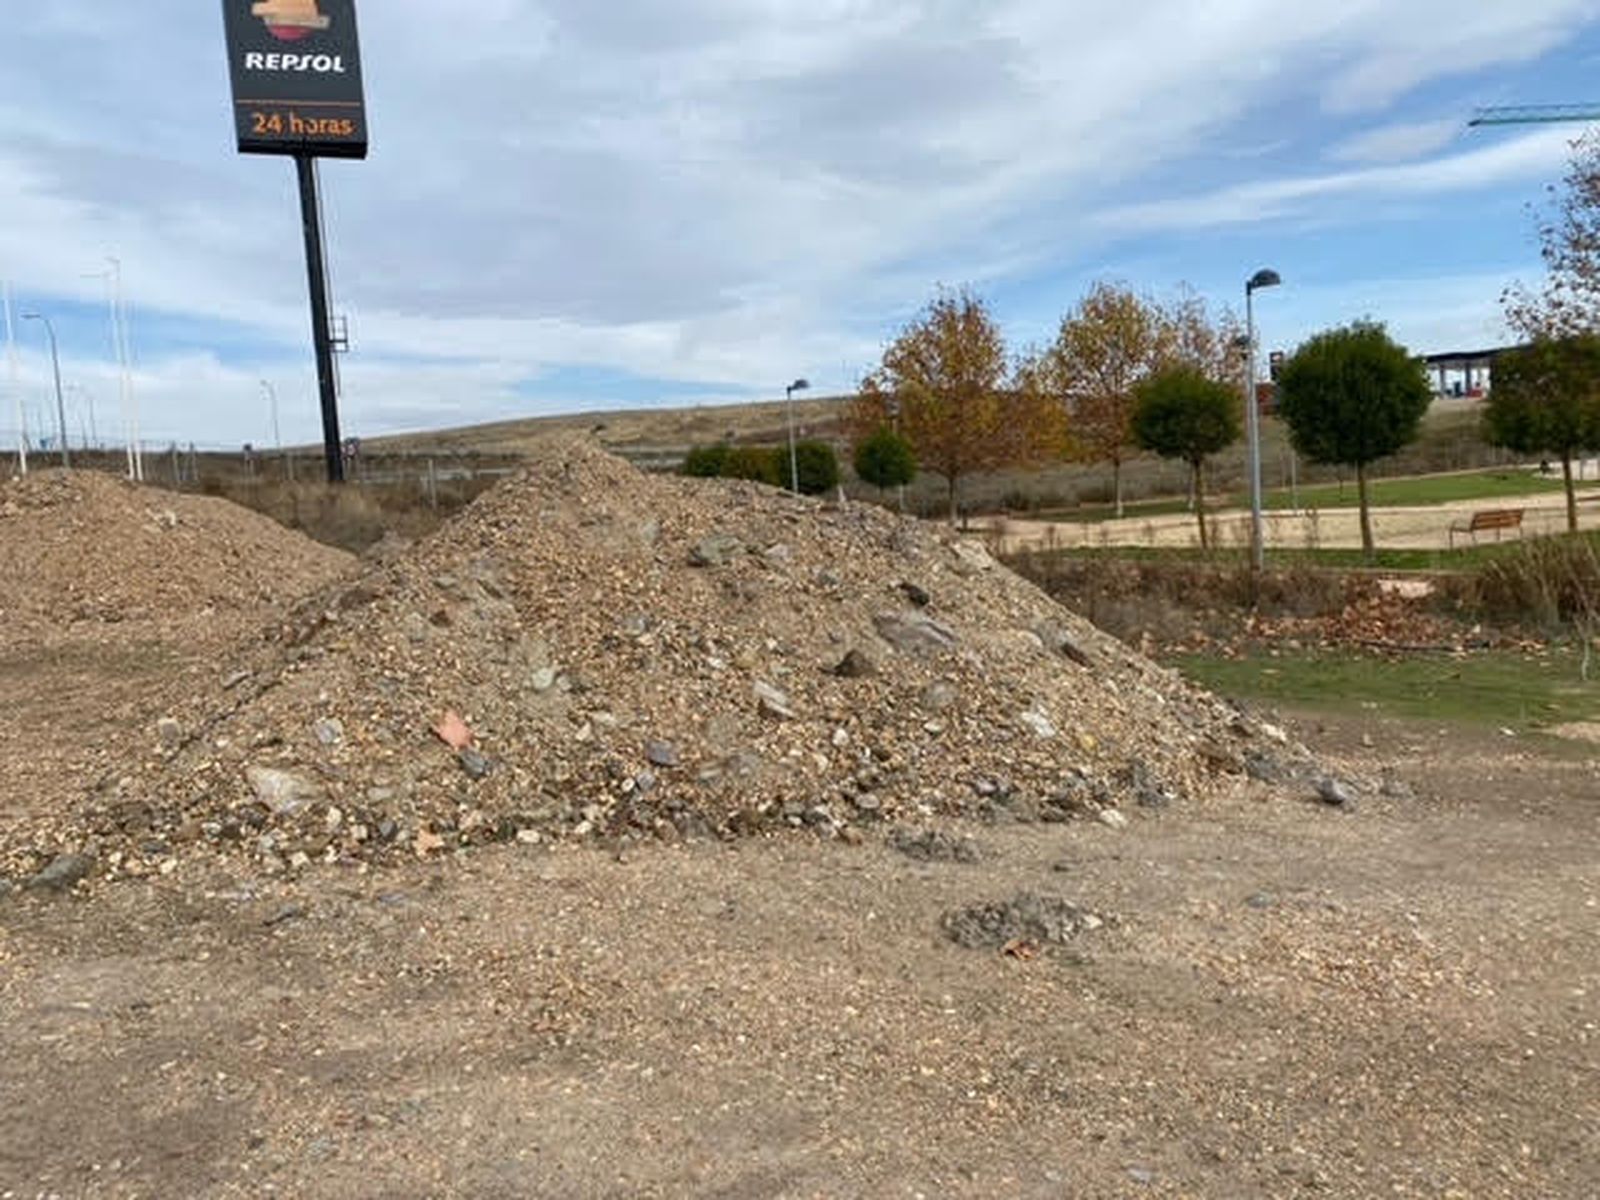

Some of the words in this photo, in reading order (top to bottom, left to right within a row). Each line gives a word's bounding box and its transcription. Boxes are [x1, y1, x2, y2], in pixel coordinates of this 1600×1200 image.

[245, 52, 345, 72] REPSOL
[252, 111, 283, 134] 24
[288, 111, 353, 135] horas
